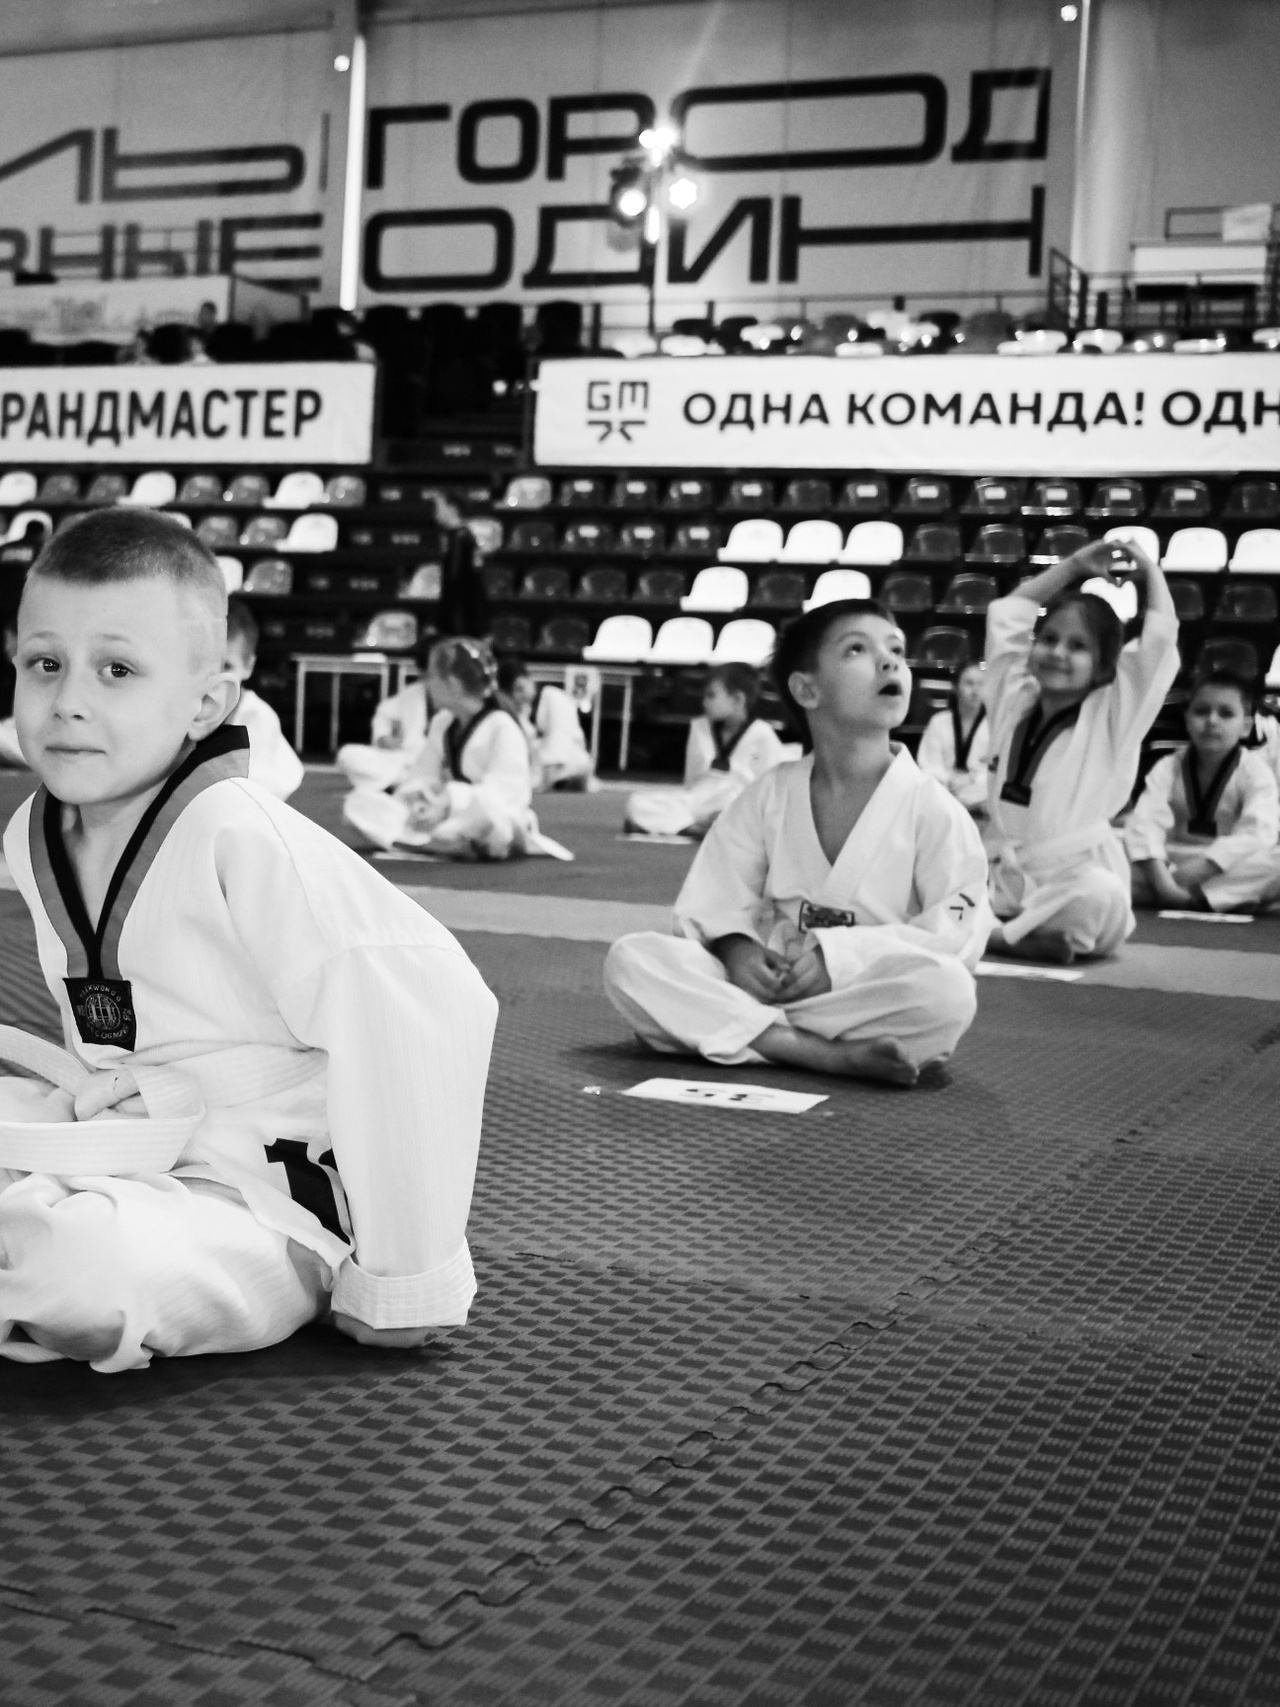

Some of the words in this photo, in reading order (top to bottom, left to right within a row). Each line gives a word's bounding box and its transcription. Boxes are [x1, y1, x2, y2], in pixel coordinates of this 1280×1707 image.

[364, 66, 1052, 190] ГОРОД
[361, 184, 1047, 292] ОДИН
[682, 392, 830, 432] ОДНА
[847, 391, 1145, 433] КОМАНДА!
